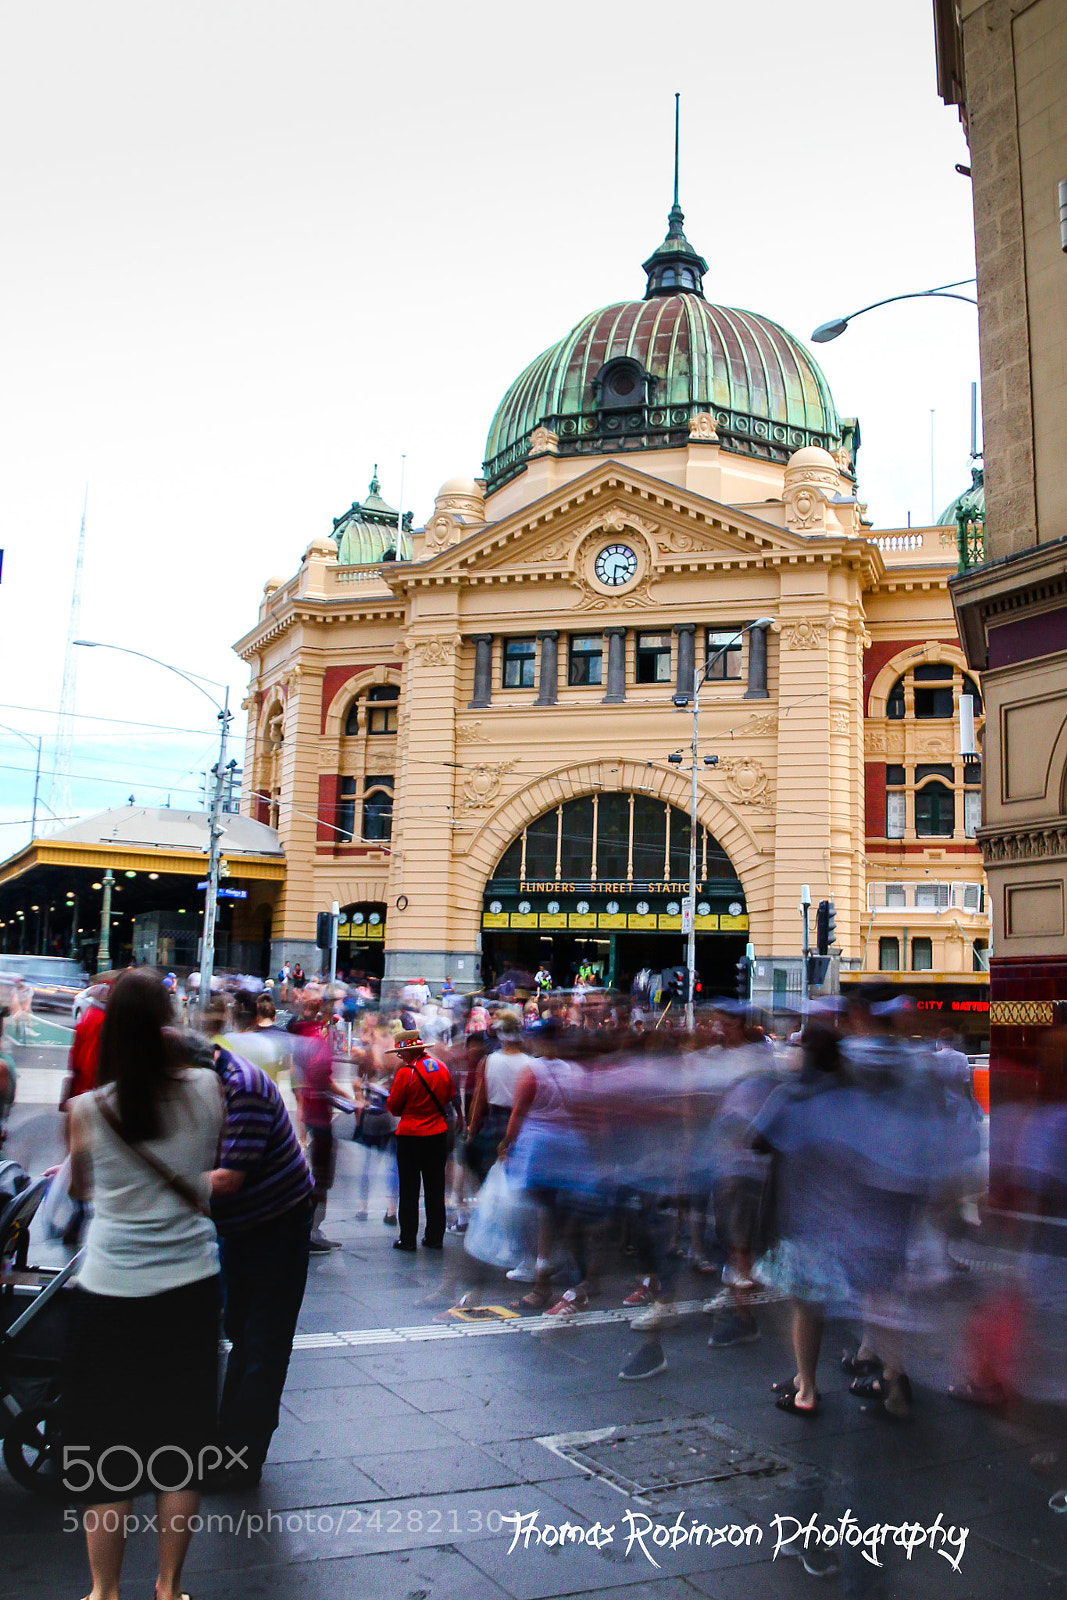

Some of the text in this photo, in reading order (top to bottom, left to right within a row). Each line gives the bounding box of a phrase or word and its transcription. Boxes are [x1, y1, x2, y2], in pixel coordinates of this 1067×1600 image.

[519, 882, 576, 893] FLINDERS
[590, 882, 633, 893] STREET
[916, 1000, 943, 1010] CITY
